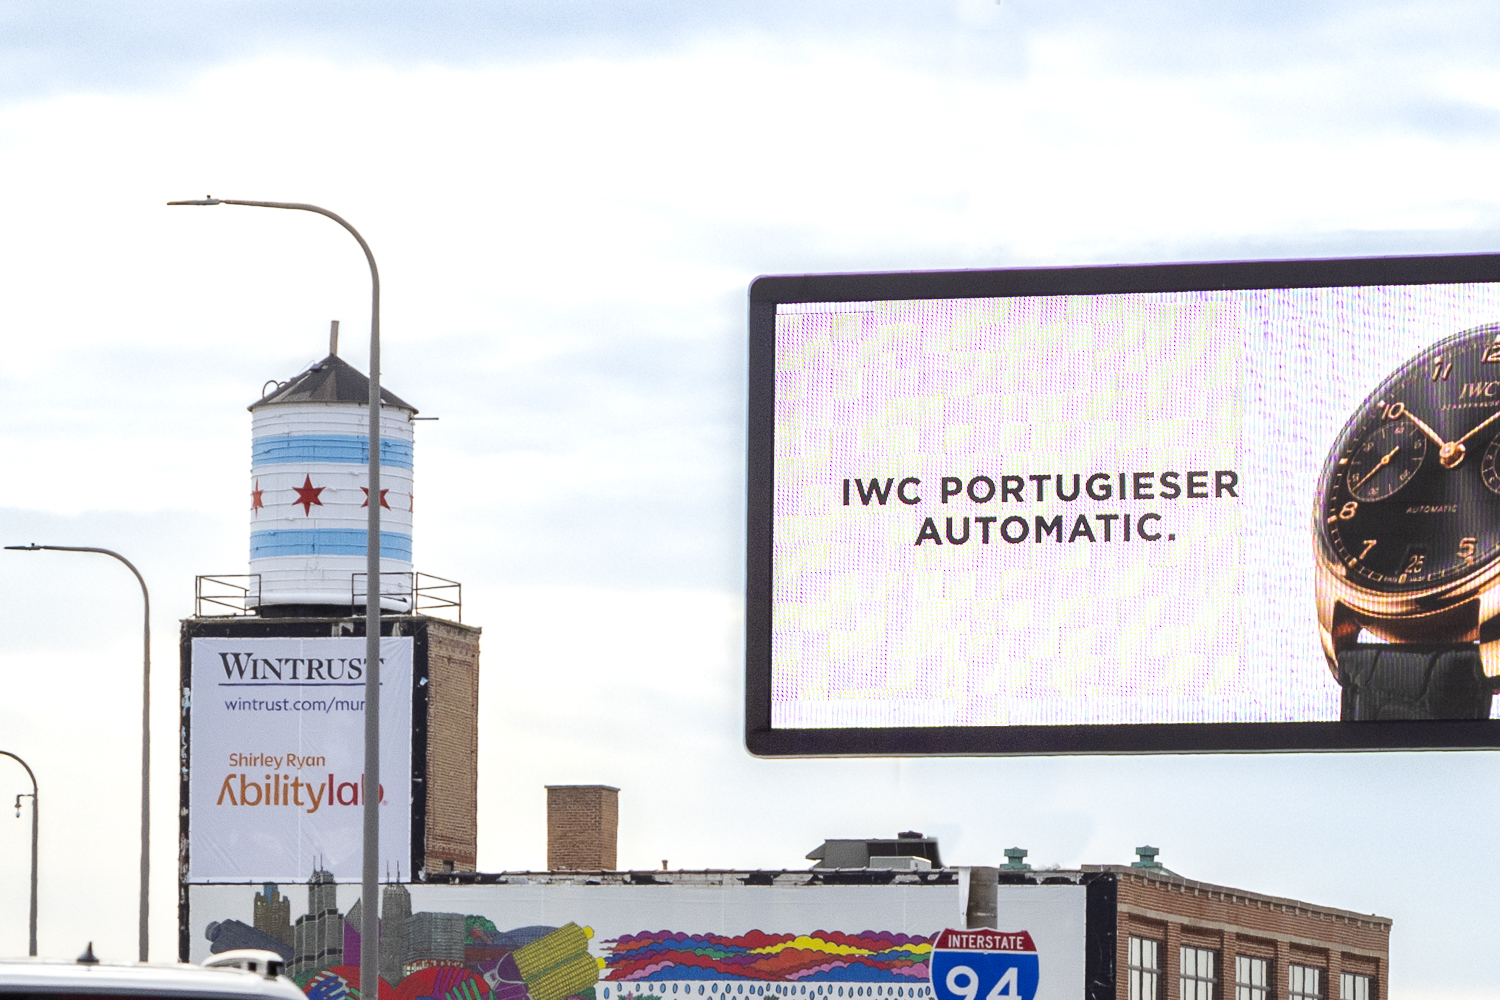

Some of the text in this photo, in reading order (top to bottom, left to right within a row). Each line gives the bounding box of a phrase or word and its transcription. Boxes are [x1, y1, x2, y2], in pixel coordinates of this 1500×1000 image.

[1432, 363, 1453, 380] 11
[1458, 381, 1500, 399] IWC
[1382, 401, 1405, 420] 10
[843, 470, 1239, 505] IWC PORTUGIESER
[1338, 501, 1358, 519] 8
[914, 513, 1176, 546] AUTOMATIC.
[1359, 540, 1377, 560] 7
[1457, 537, 1477, 559] 5
[225, 697, 367, 713] wintrust.com/mur
[229, 753, 326, 770] Shirley Ryan
[948, 934, 1025, 950] INTERSTATE
